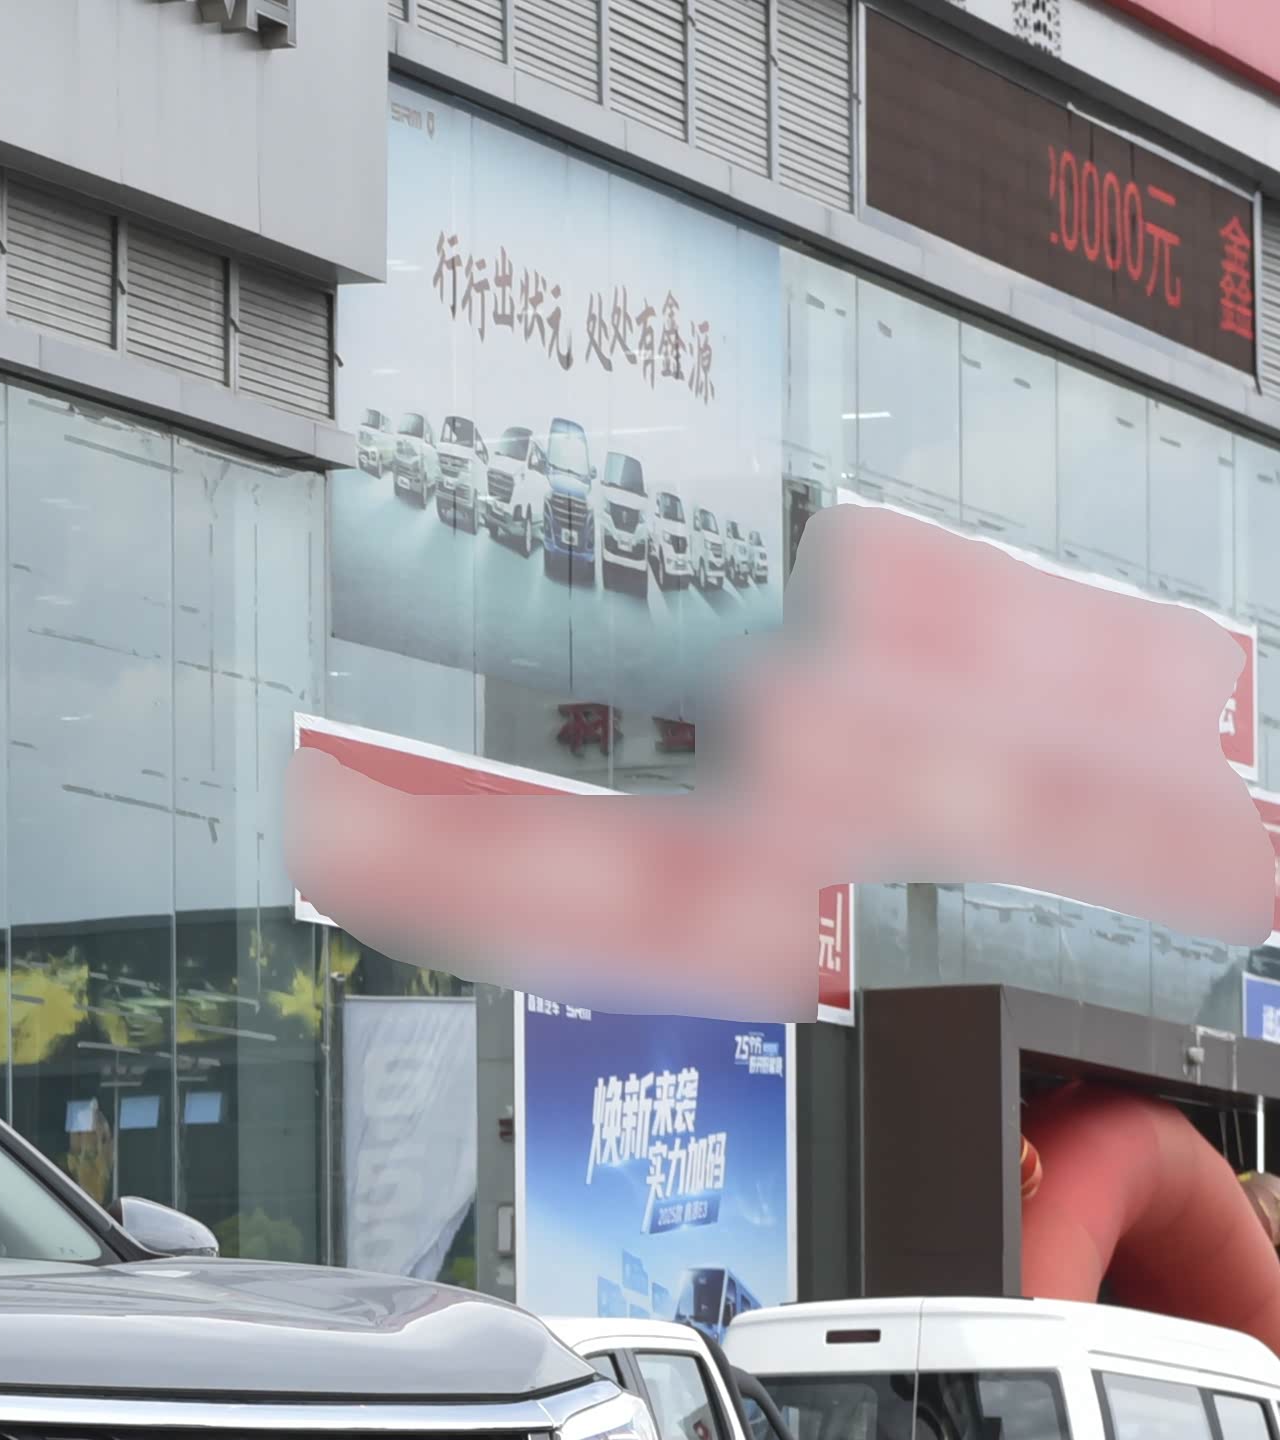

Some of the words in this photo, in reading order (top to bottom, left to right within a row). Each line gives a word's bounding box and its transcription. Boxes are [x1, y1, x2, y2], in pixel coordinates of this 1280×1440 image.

[1048, 145, 1182, 308] 0000元
[432, 230, 574, 372] 行行出状元
[585, 283, 716, 406] 处处有鑫源
[586, 1066, 700, 1182] 焕新来袭
[644, 1131, 727, 1212] 实力加码
